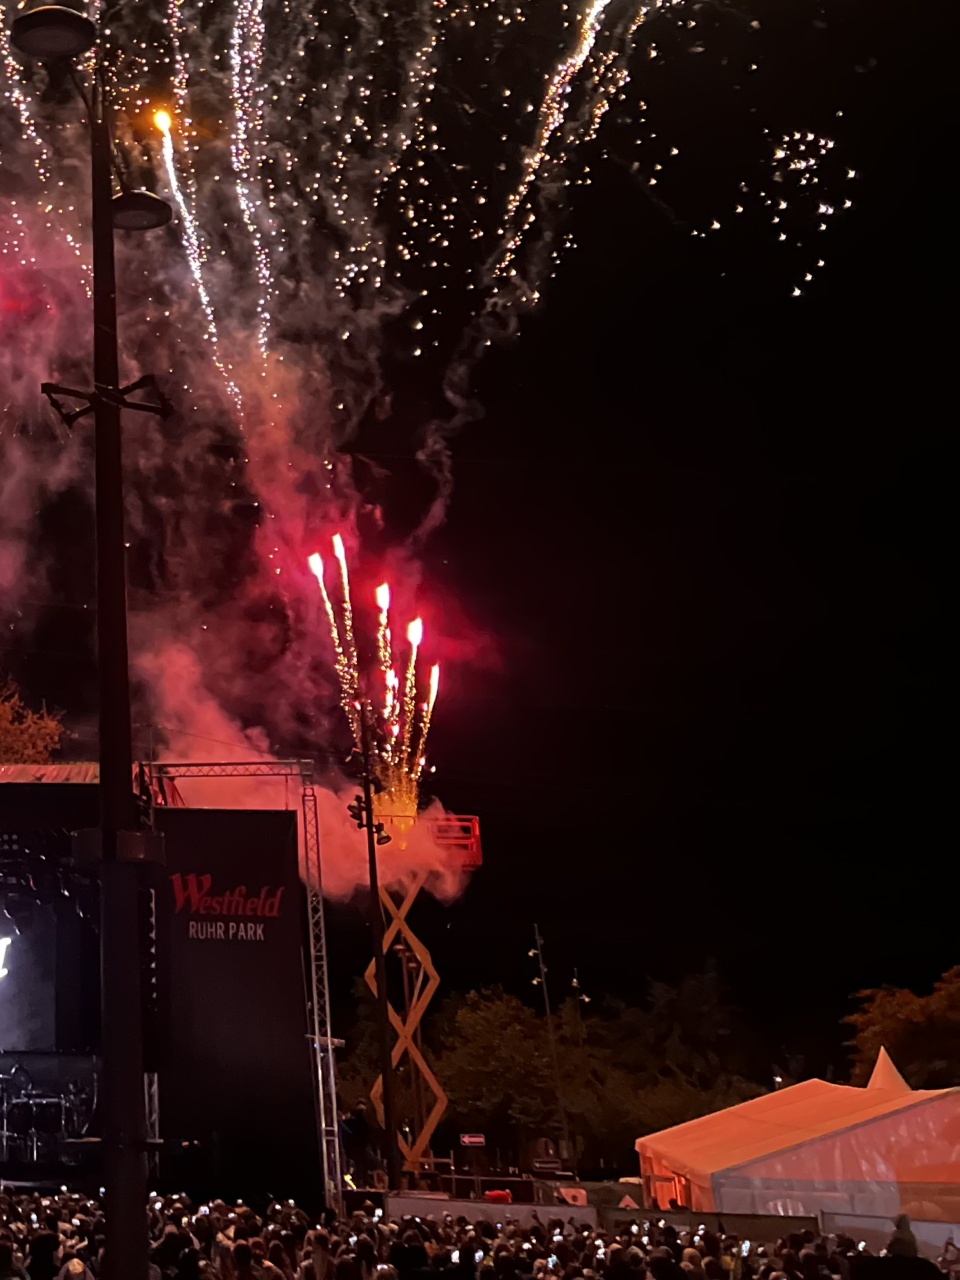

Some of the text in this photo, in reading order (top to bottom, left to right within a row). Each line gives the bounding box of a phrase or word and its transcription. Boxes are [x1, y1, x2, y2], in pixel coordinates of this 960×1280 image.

[169, 872, 286, 917] Westfield
[188, 920, 265, 941] RUHR PARK
